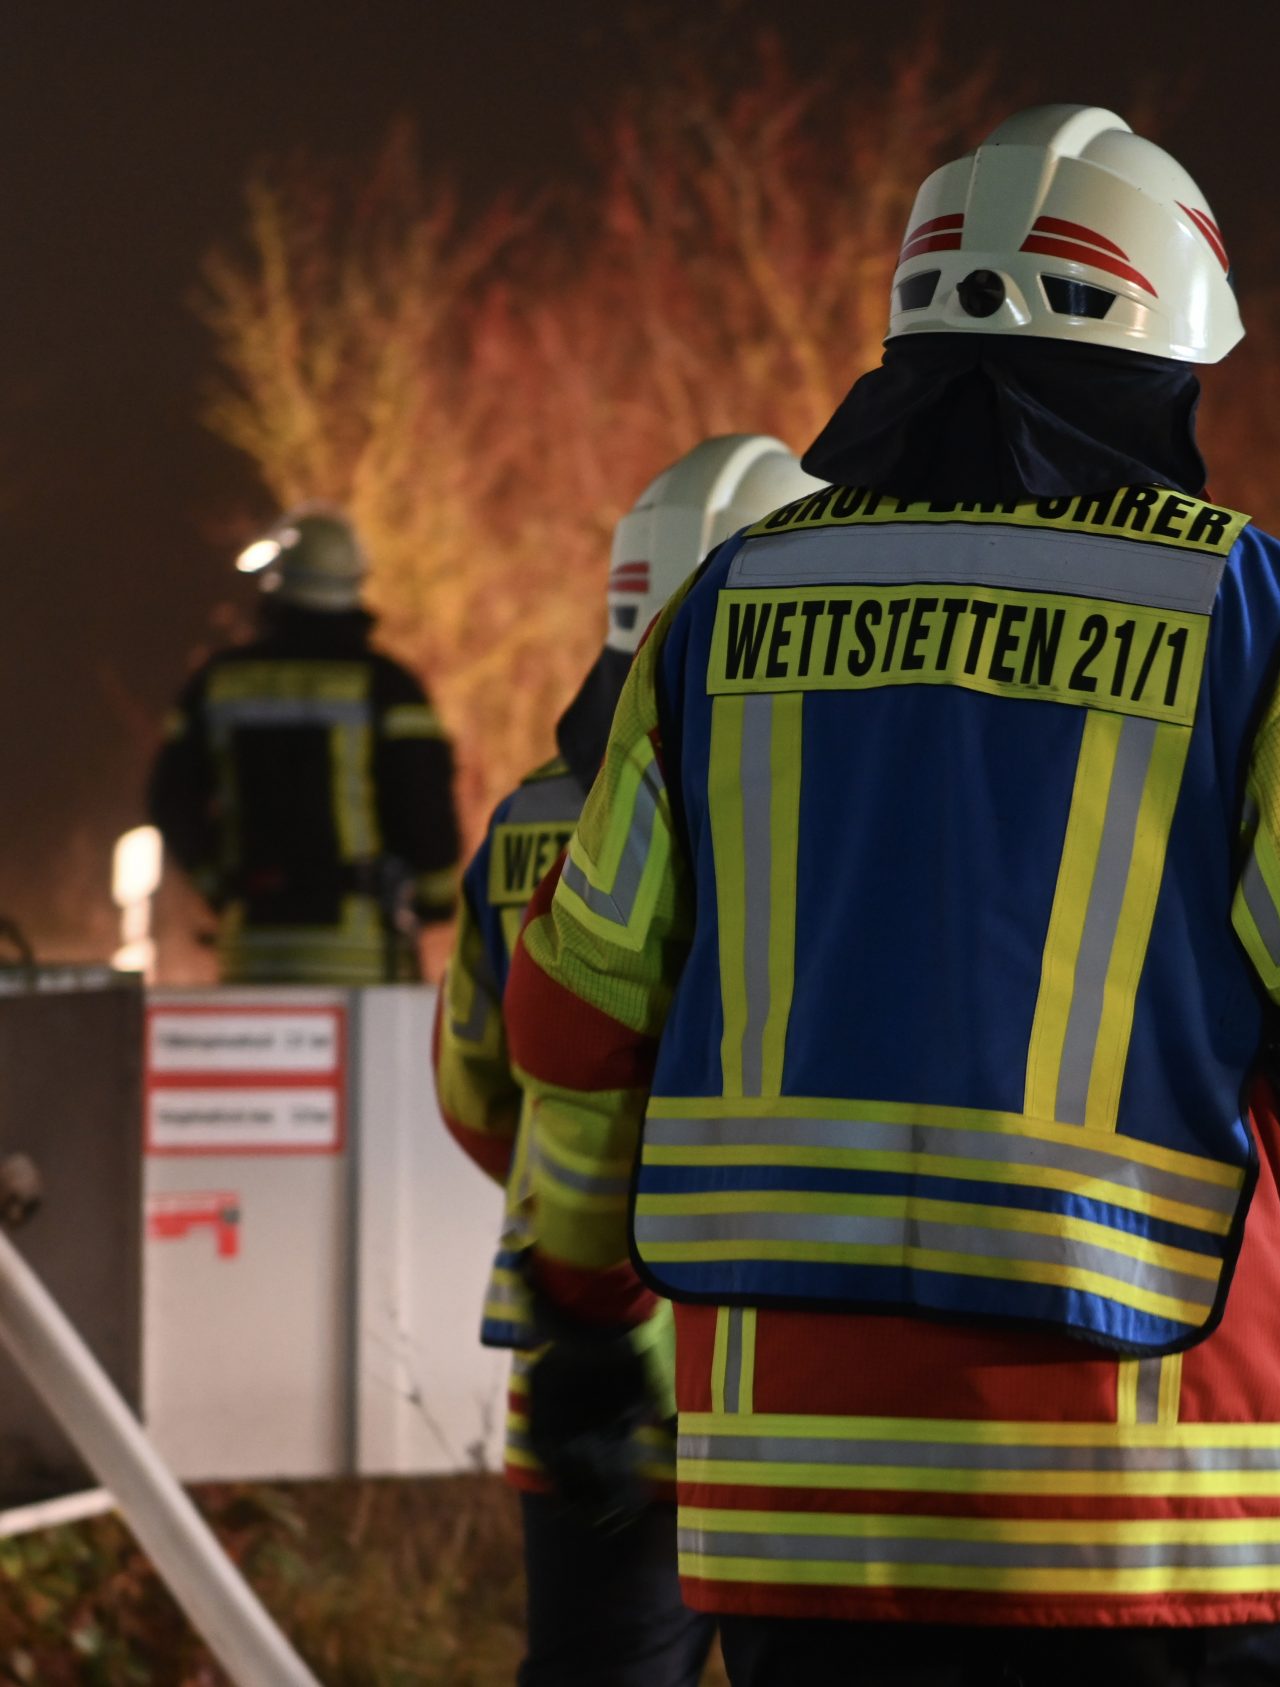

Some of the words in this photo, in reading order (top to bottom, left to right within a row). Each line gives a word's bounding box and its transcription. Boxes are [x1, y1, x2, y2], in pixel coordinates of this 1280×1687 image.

[765, 485, 1232, 545] GRUHRER
[725, 597, 1066, 686] WETTSTETTEN
[1069, 613, 1188, 707] 21/1
